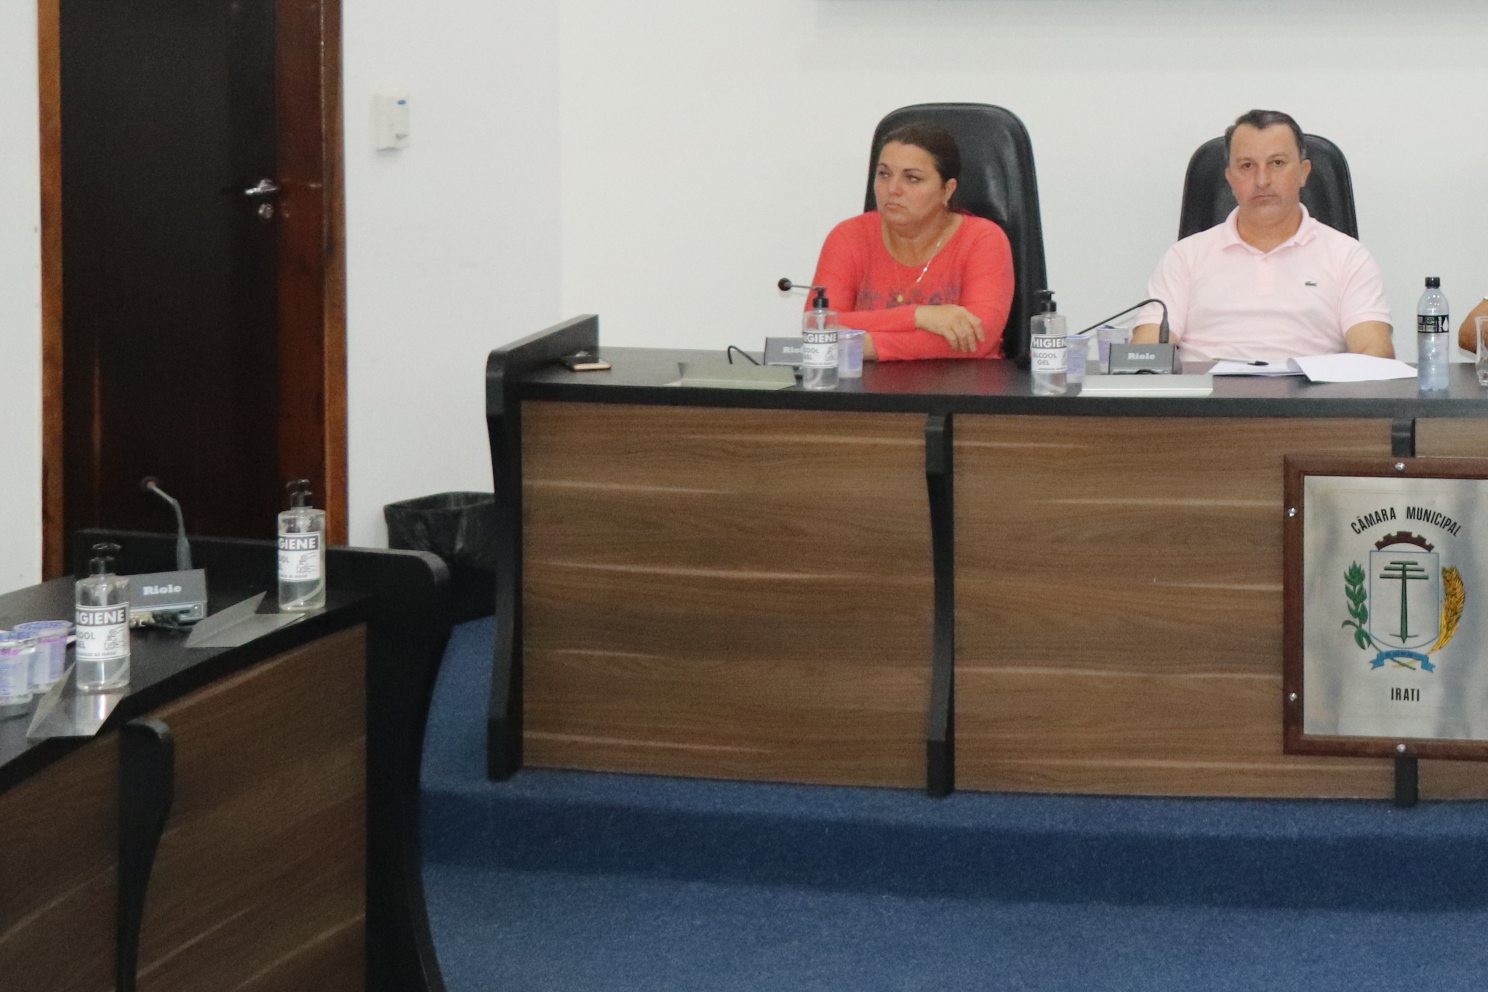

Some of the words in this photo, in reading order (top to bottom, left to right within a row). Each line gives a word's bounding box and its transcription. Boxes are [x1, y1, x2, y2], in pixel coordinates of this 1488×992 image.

[1127, 352, 1156, 360] Riole
[1350, 506, 1397, 535] CÂMARA
[1406, 506, 1462, 538] MUNICIPAL
[142, 584, 182, 596] Riole
[1390, 686, 1421, 702] IRATI
